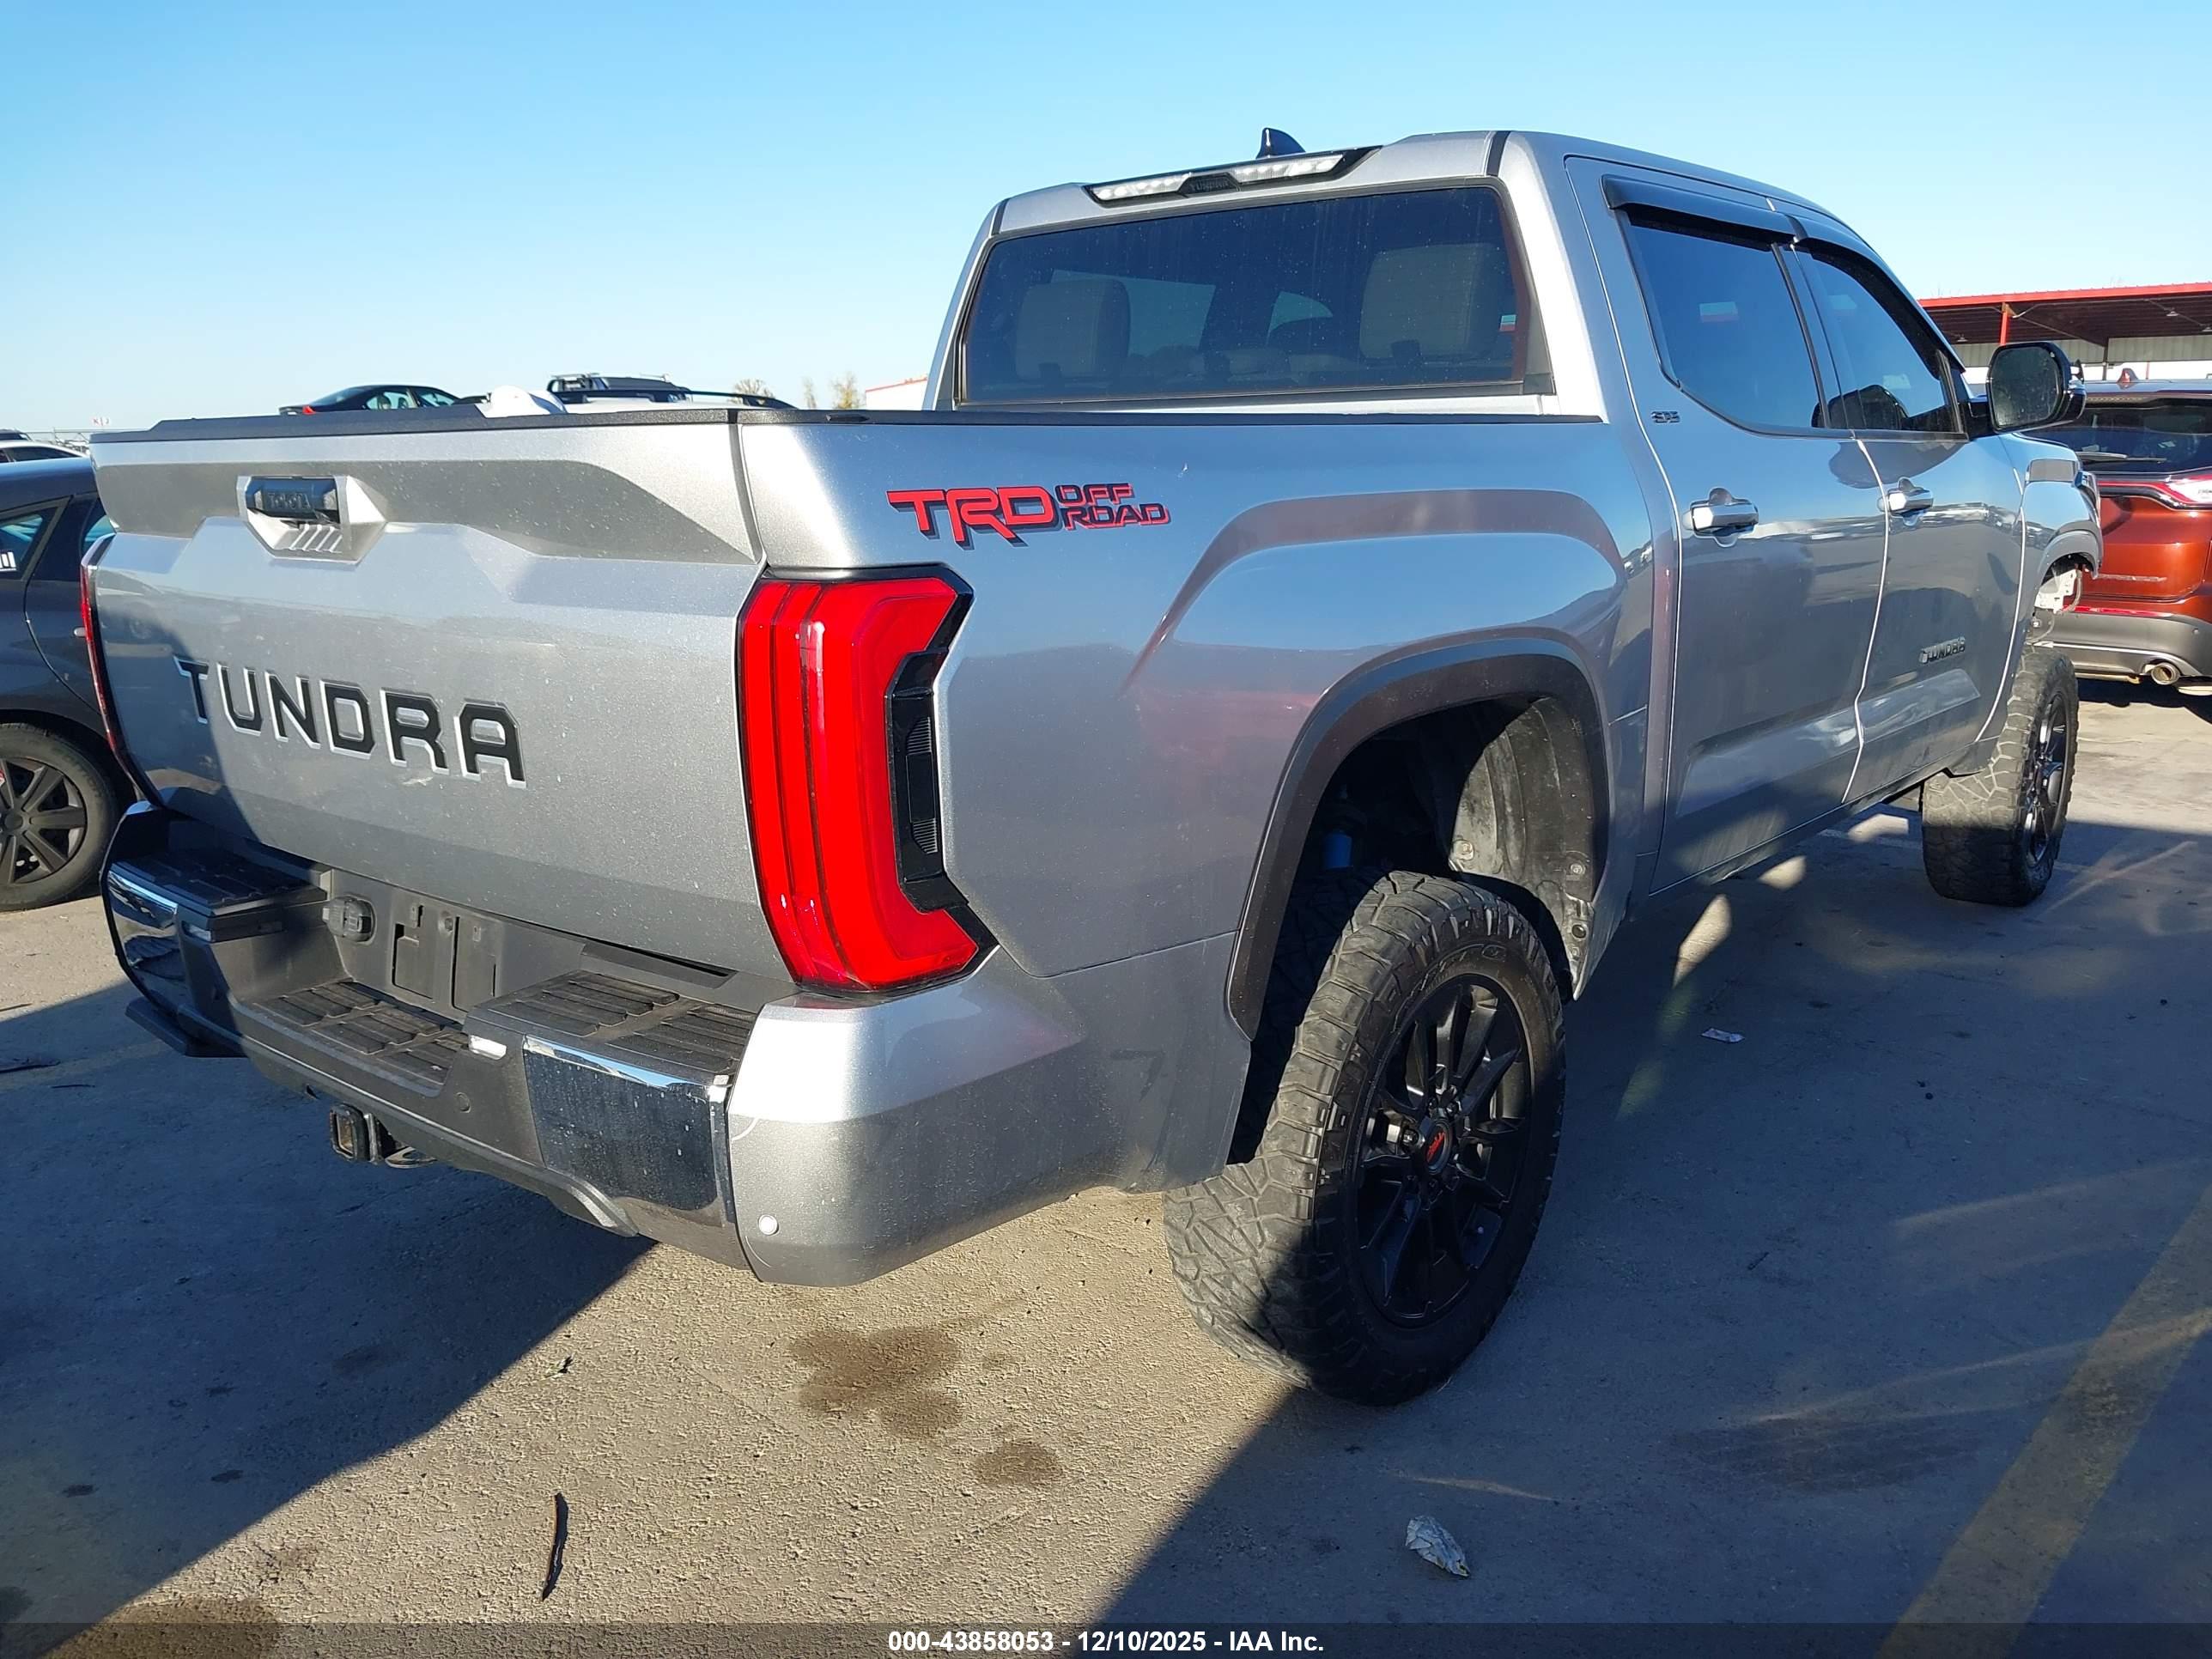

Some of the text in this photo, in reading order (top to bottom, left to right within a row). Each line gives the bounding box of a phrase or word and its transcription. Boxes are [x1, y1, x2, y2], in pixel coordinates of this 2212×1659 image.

[886, 483, 1135, 550] TRD OFF
[1060, 503, 1171, 531] ROAD
[173, 655, 527, 788] TUNDRA
